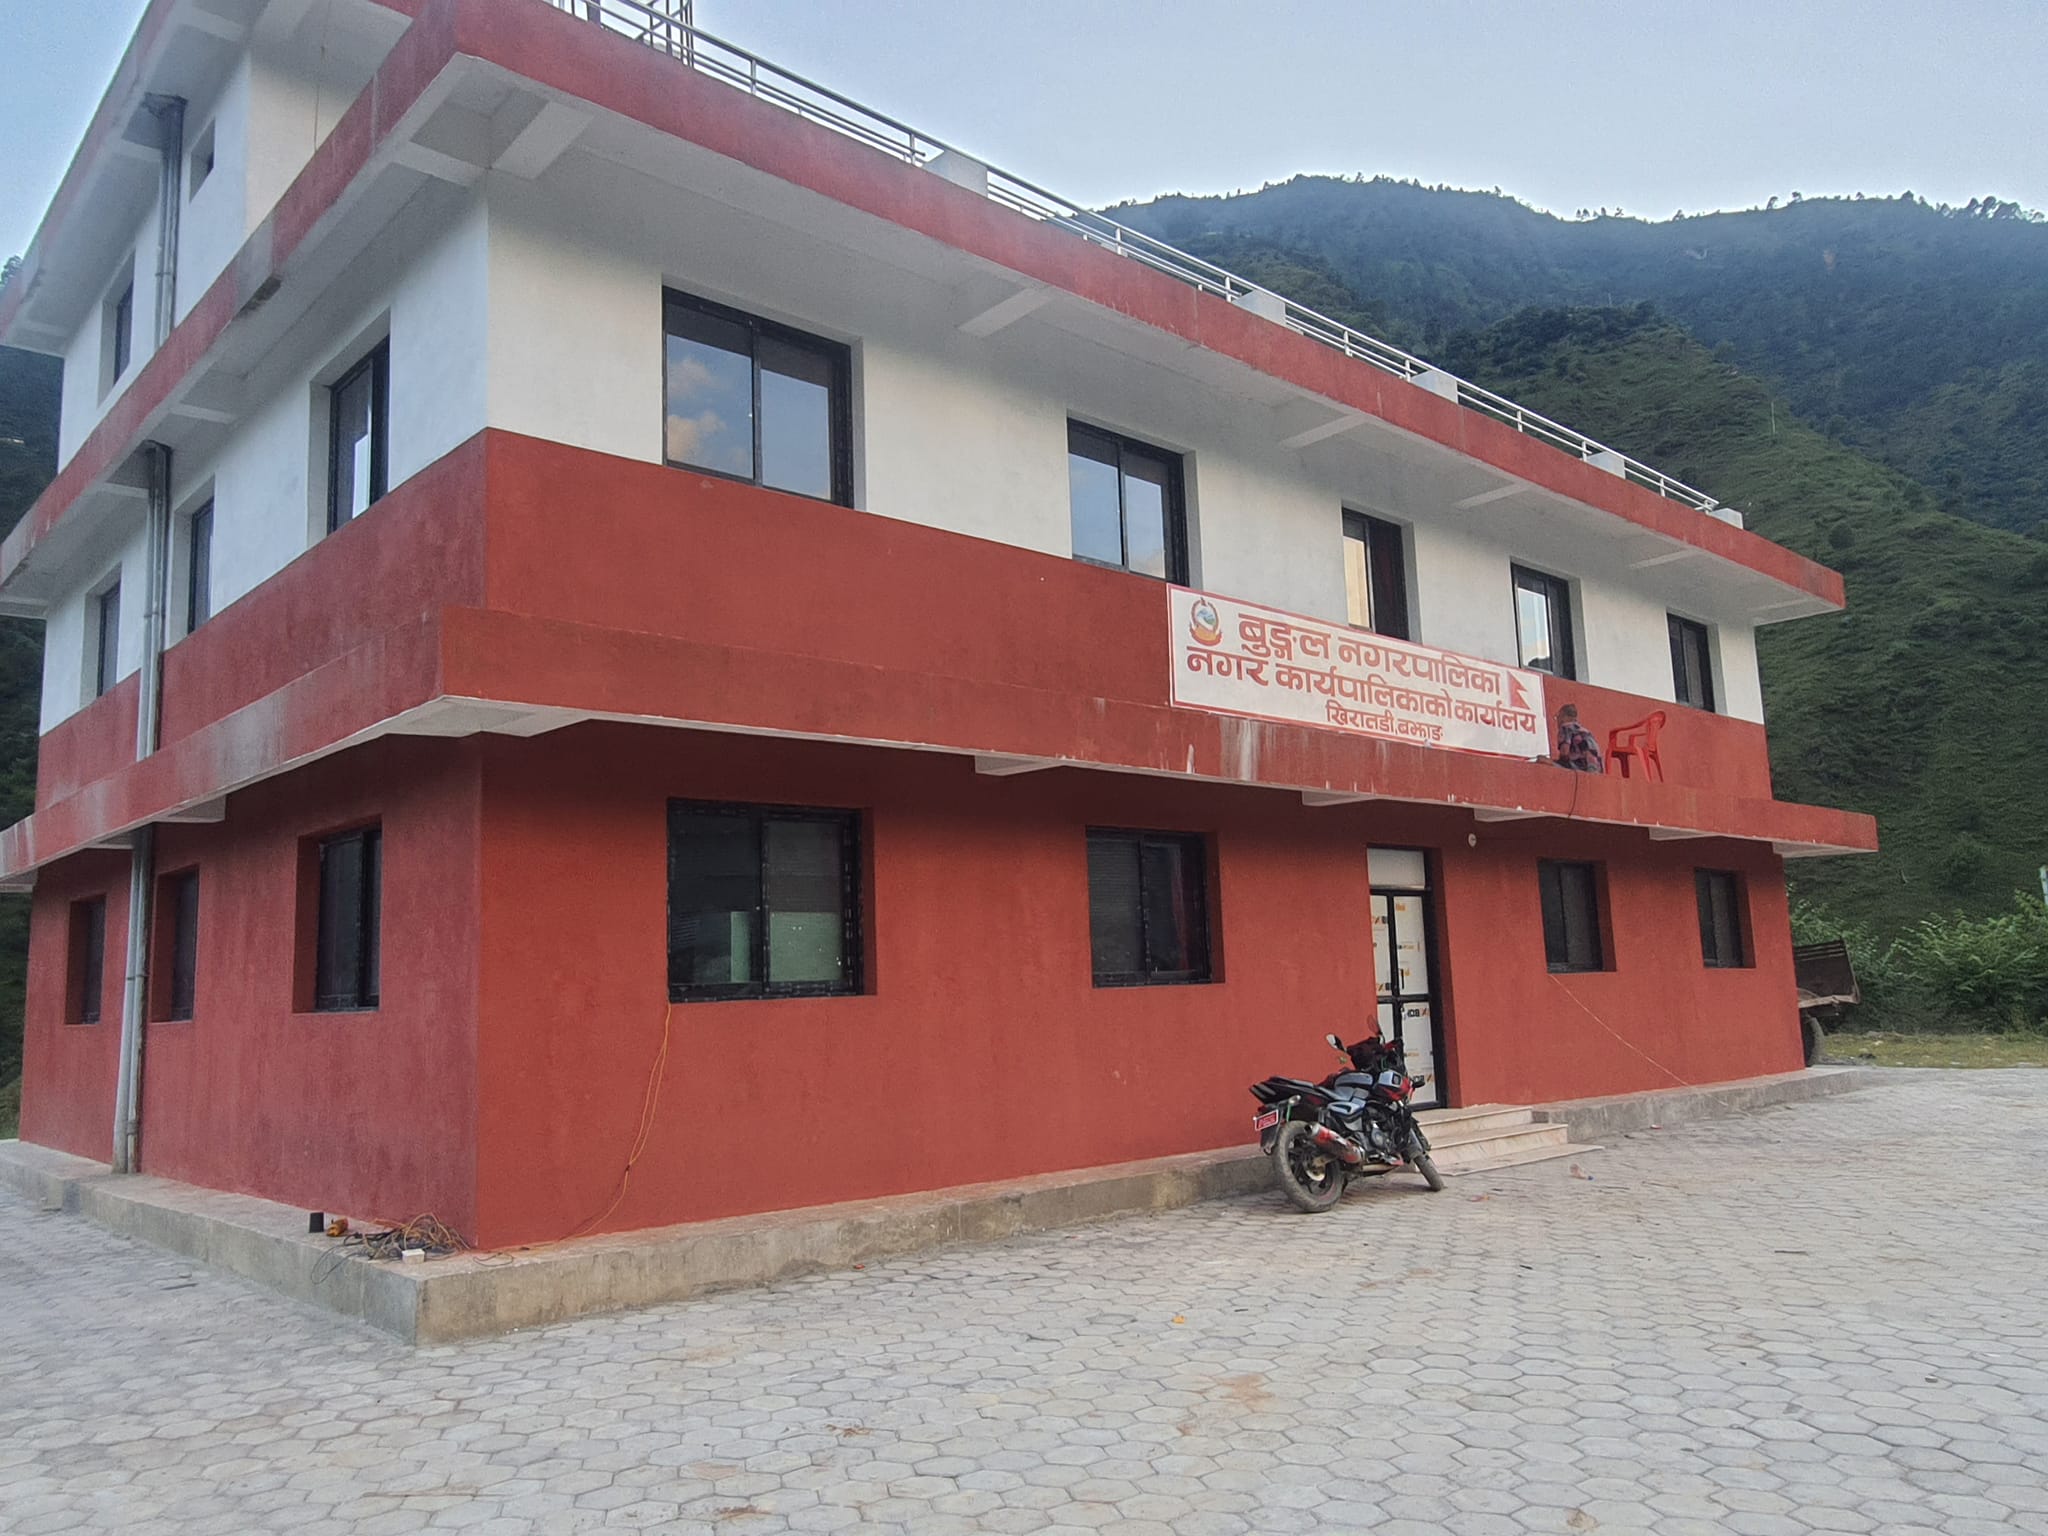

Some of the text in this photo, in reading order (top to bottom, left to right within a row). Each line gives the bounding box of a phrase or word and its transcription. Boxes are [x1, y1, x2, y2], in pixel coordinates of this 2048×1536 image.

[1186, 646, 1536, 734] नगर कार्यपालिकाको कार्यालय
[1338, 636, 1501, 696] नगरपालिका
